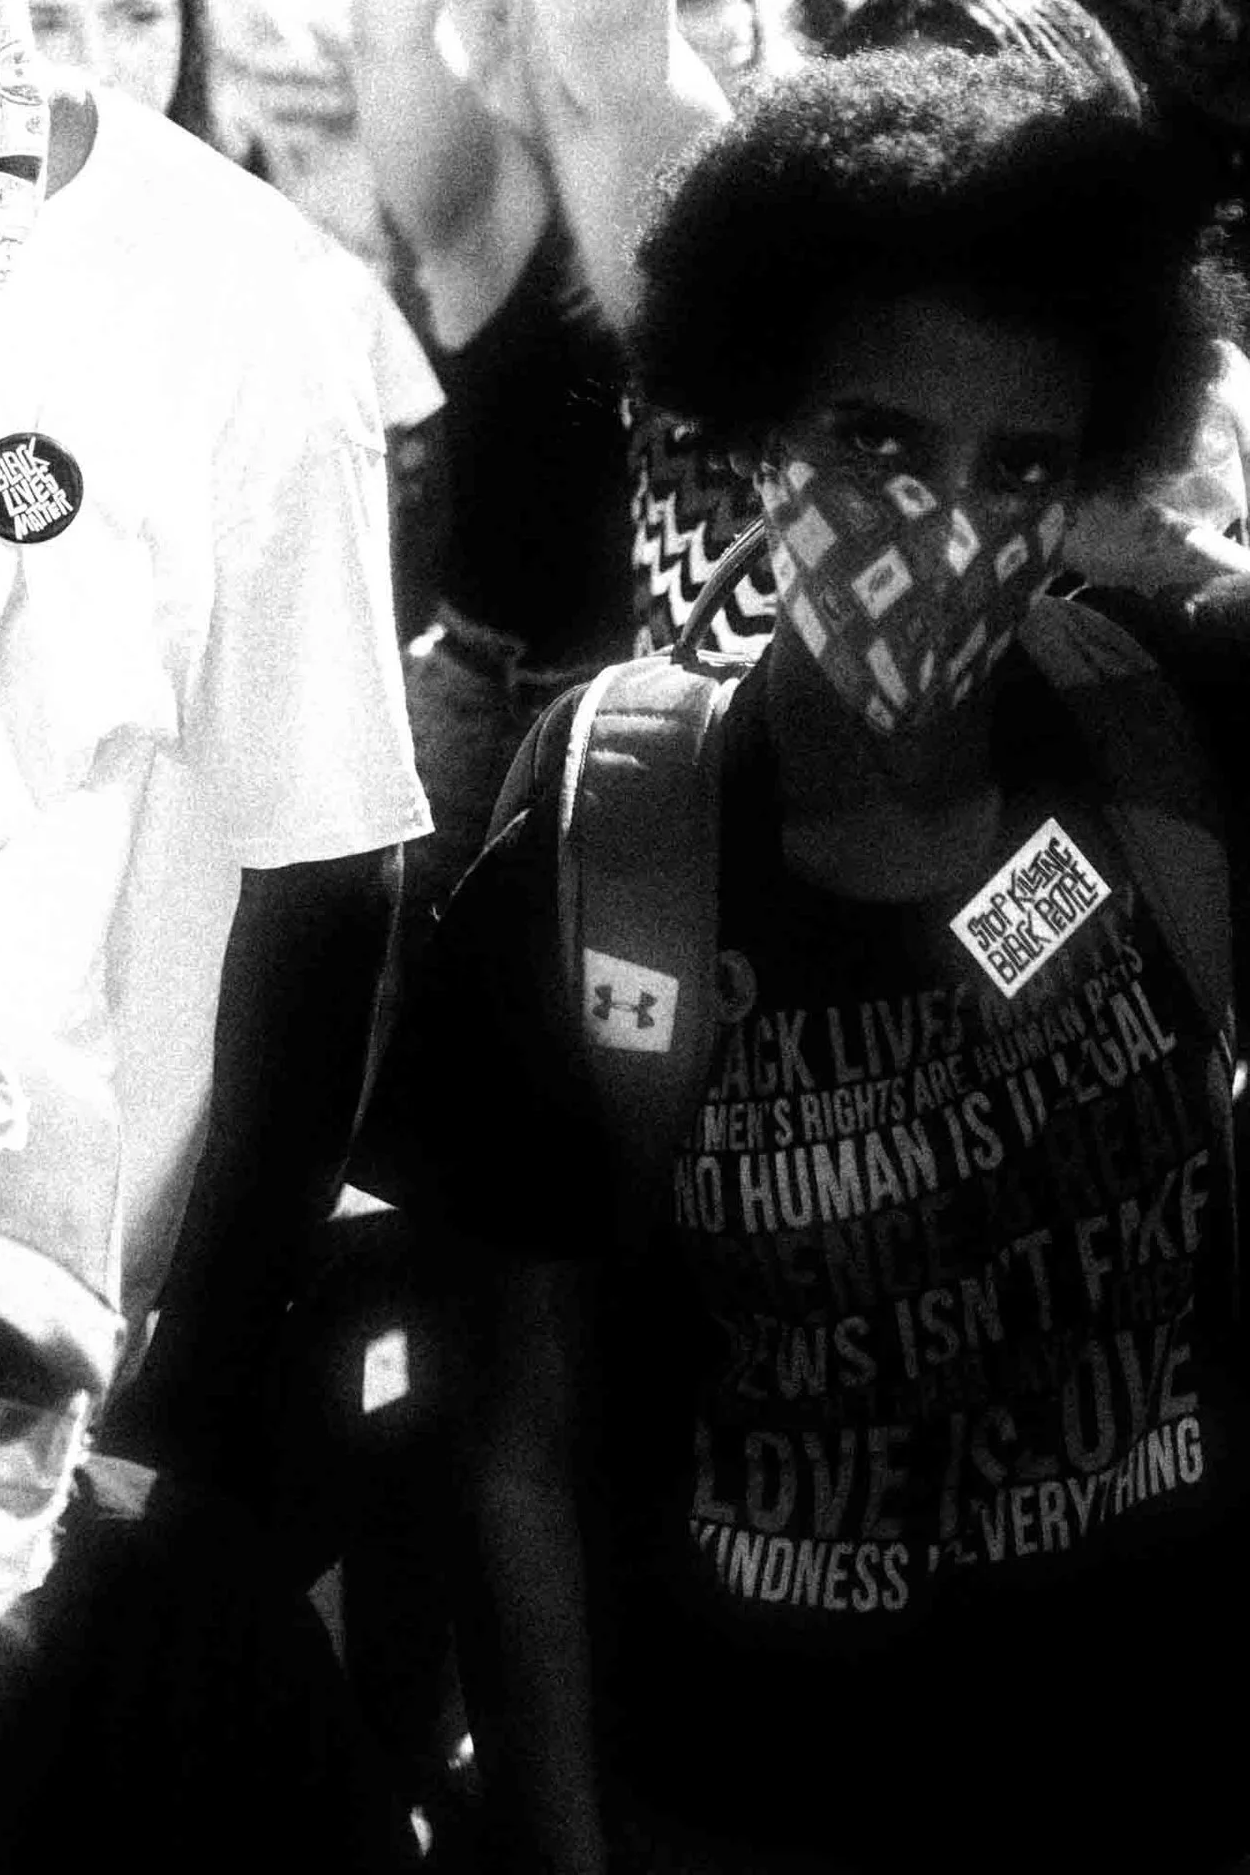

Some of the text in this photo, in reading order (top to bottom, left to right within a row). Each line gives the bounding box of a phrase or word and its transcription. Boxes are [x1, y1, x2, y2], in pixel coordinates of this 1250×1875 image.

[2, 464, 60, 518] LIVES
[13, 488, 74, 541] MATTER
[967, 836, 1074, 953] STOP KILLING
[986, 910, 1053, 985] BLACK
[1033, 859, 1100, 937] PEOPLE
[695, 1096, 795, 1153] MEN'S
[800, 1077, 908, 1142] RIGHTS
[911, 1053, 974, 1116] ARE
[972, 997, 1088, 1084] HUMAN
[708, 1008, 816, 1103] ACK
[673, 1153, 723, 1234] NO
[738, 1118, 941, 1234] HUMAN
[944, 1091, 1006, 1181] IS
[894, 1227, 1053, 1381] ISN'T
[1074, 1147, 1211, 1315] FAKE
[692, 1415, 913, 1540] LOVE
[1014, 1322, 1200, 1477] OVE
